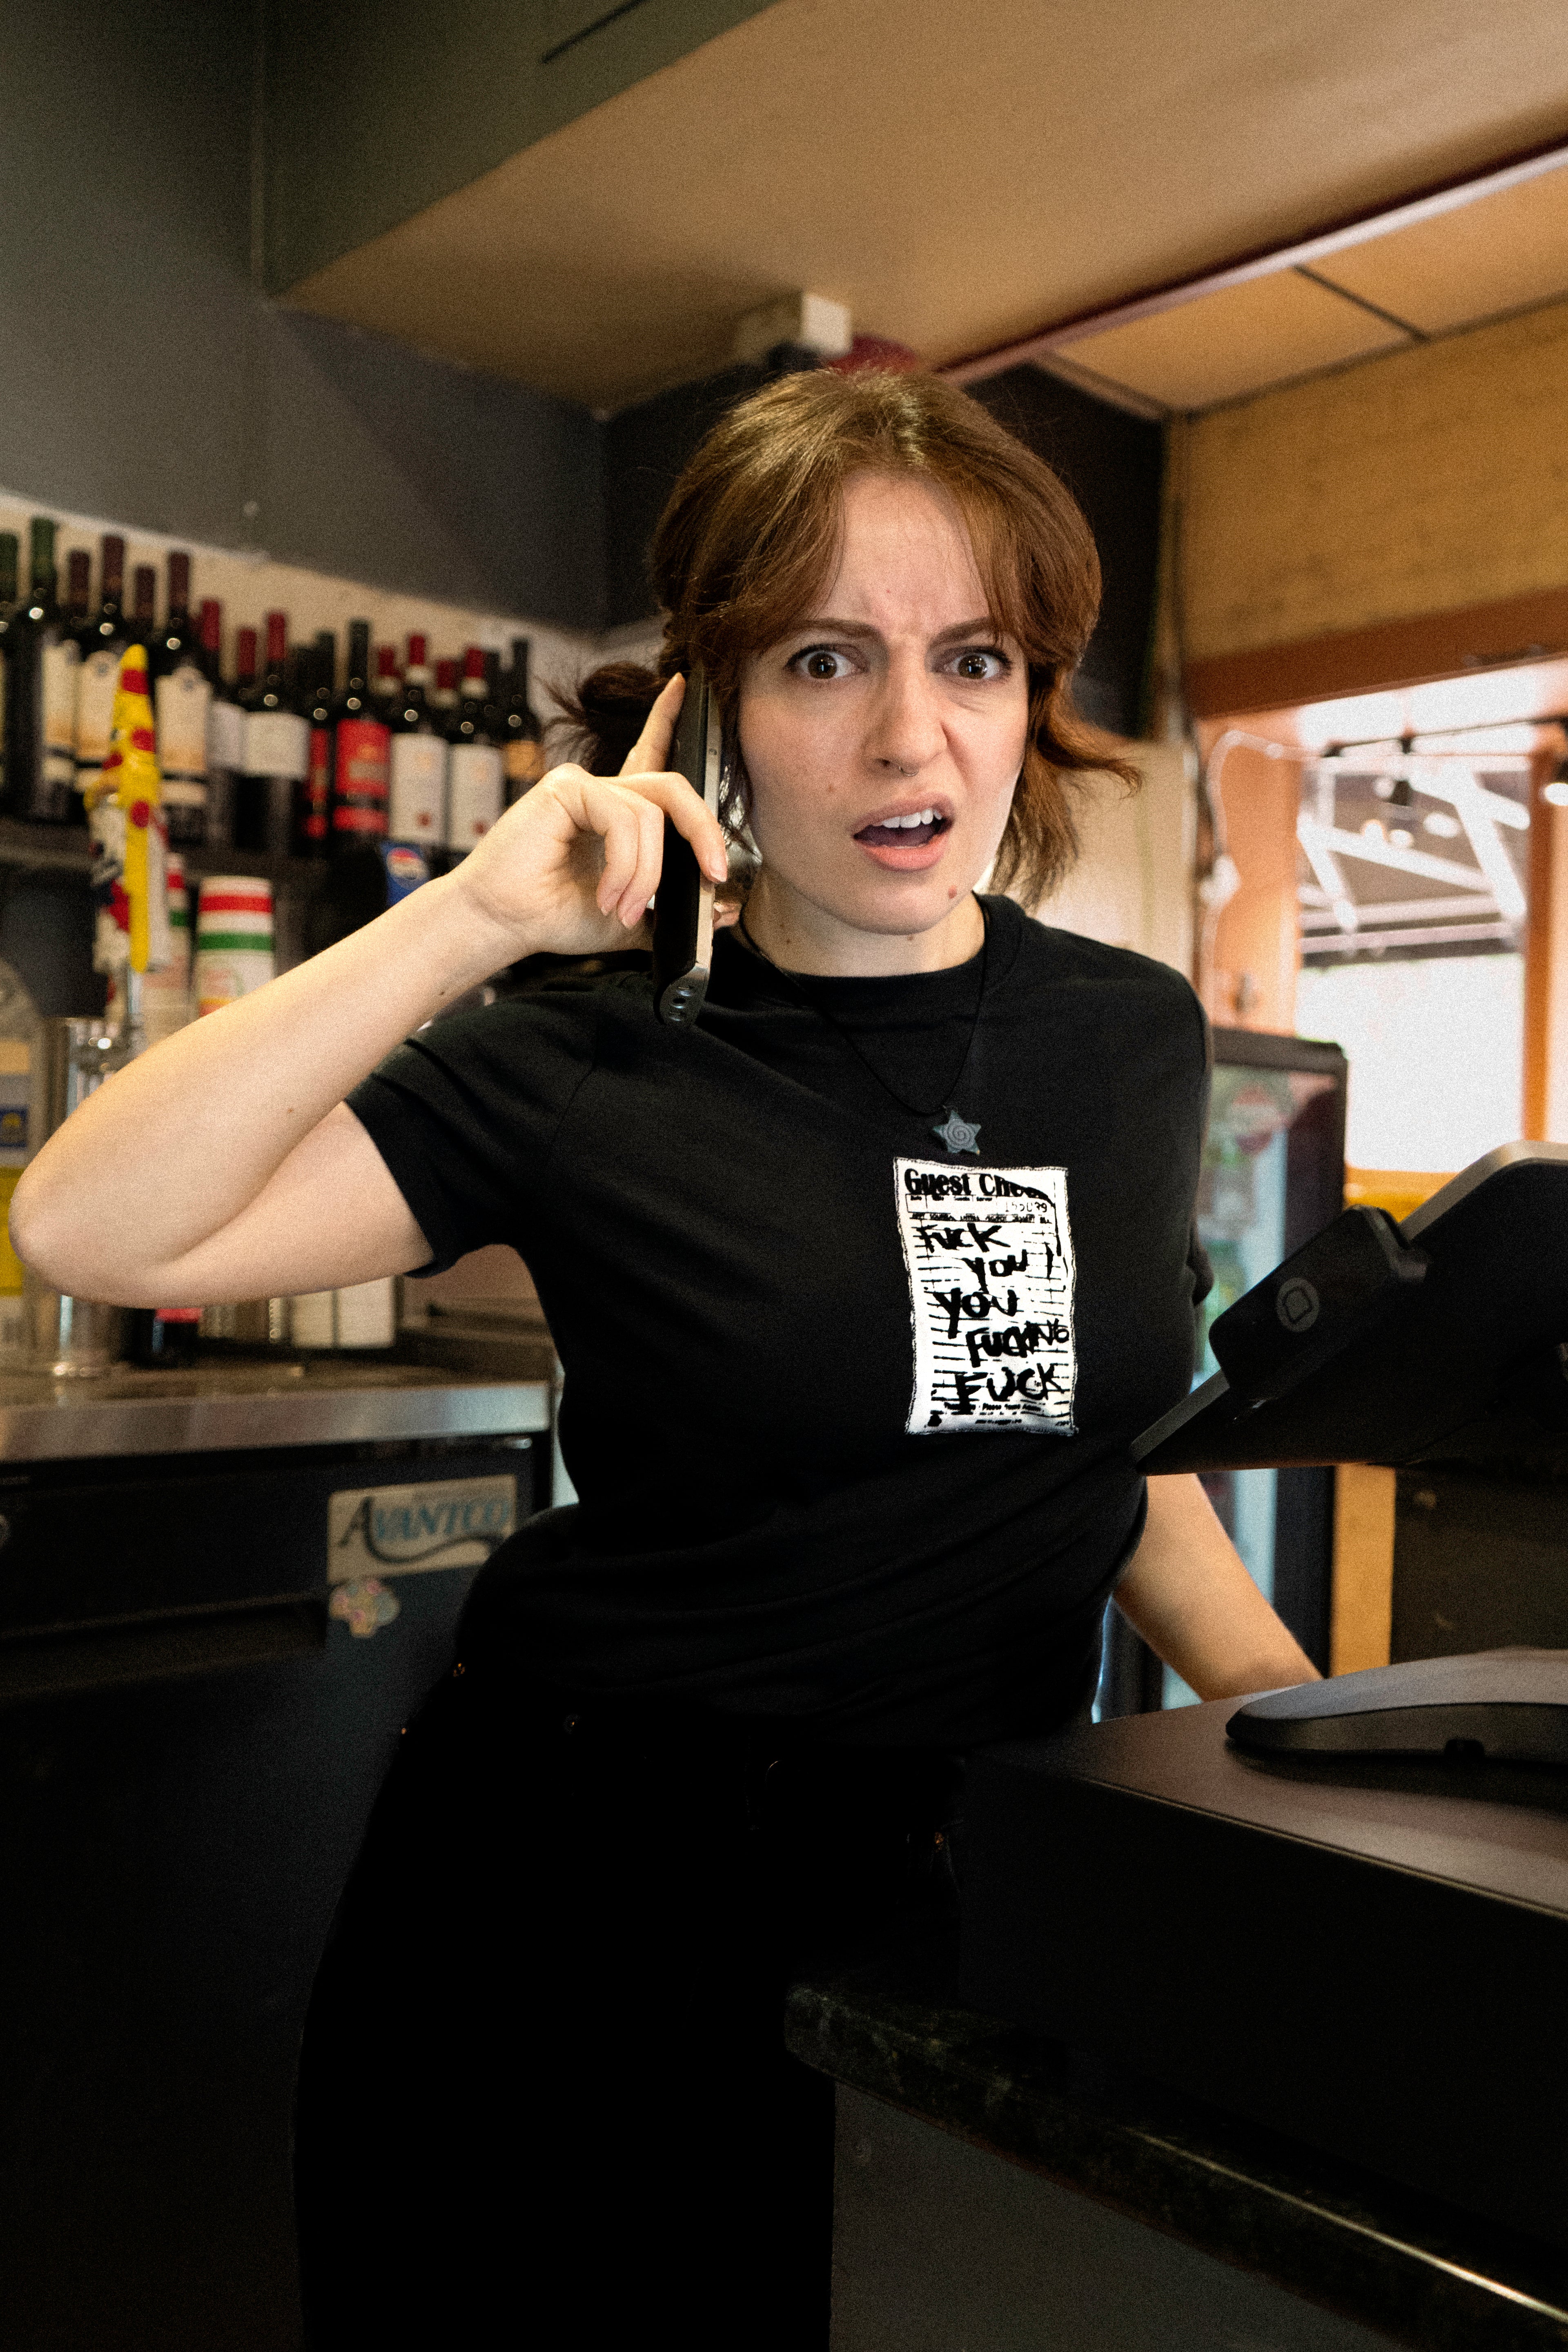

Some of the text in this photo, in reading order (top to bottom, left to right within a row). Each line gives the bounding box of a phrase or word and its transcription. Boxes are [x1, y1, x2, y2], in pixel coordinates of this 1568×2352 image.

[904, 1168, 1049, 1199] Guest Che
[933, 1287, 1018, 1339] YOU
[954, 1363, 1064, 1414] FUCK
